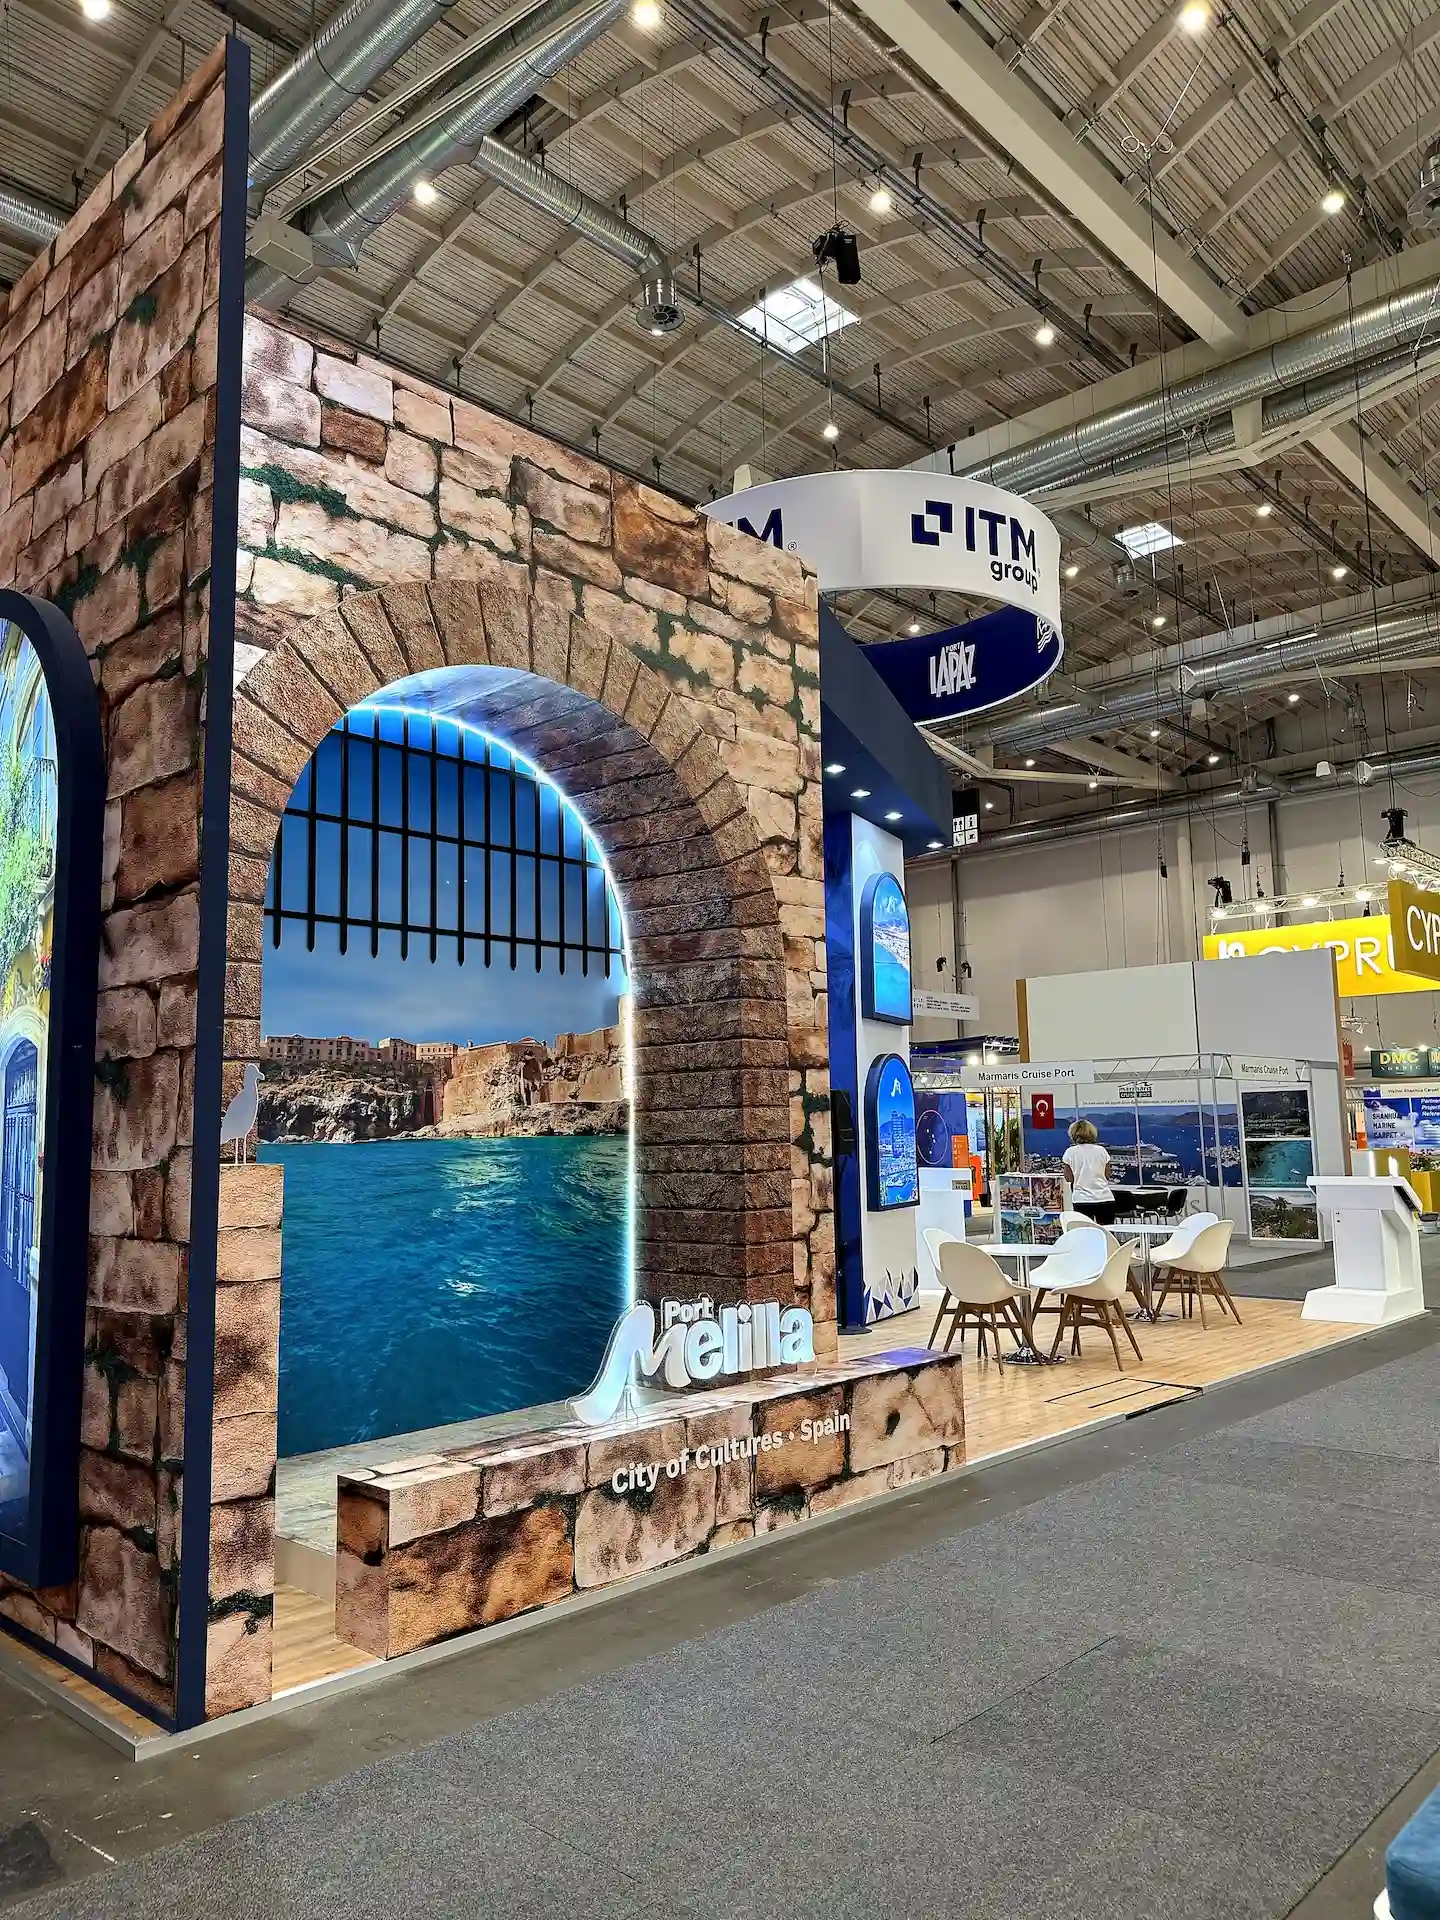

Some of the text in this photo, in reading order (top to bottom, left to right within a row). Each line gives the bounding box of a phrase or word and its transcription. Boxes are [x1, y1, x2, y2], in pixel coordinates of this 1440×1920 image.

[965, 506, 1037, 573] ITM
[990, 560, 1038, 594] group
[1241, 1063, 1289, 1075] Marmaris Cruise Port
[1379, 1051, 1419, 1065] DMC
[978, 1068, 1075, 1081] Marmaris Cruise Port
[1373, 1131, 1397, 1139] CARPET
[664, 1297, 714, 1328] Port
[571, 1302, 815, 1426] Melilla
[611, 1410, 850, 1494] City of Cultures Spain
